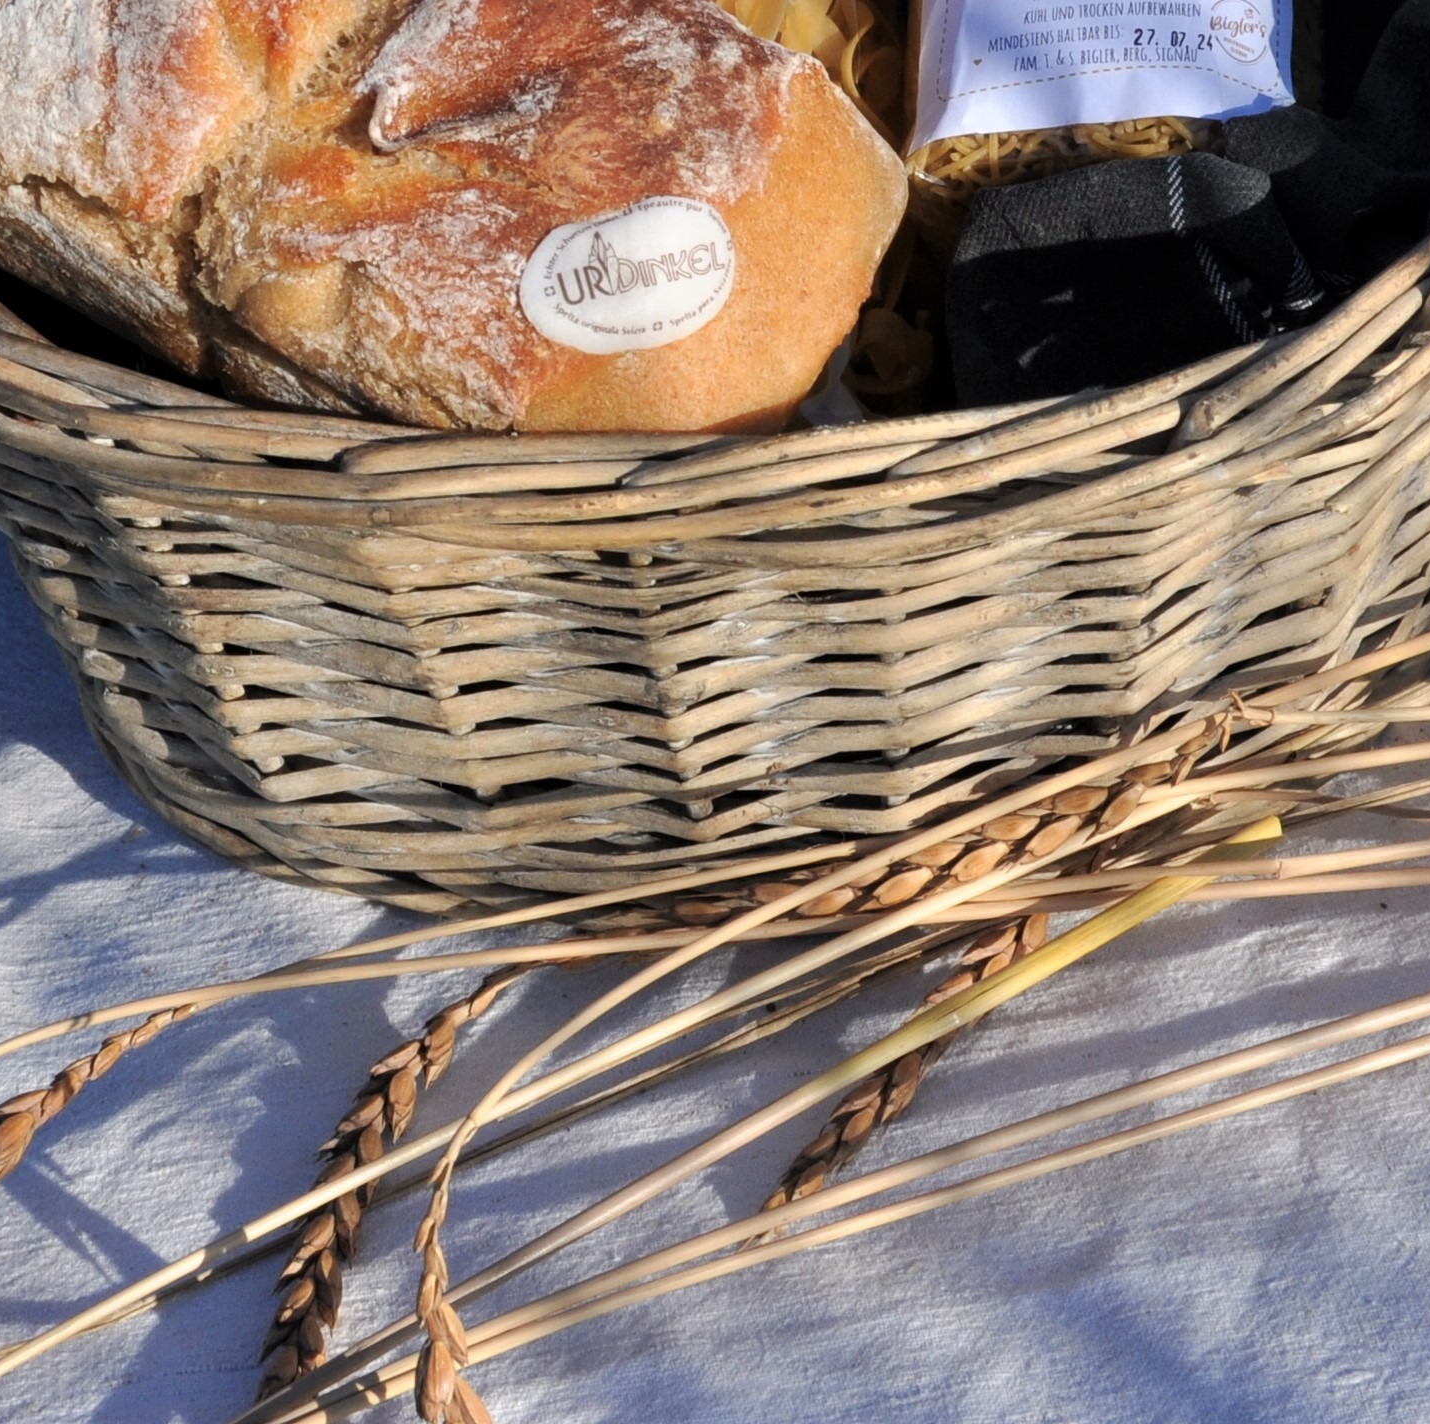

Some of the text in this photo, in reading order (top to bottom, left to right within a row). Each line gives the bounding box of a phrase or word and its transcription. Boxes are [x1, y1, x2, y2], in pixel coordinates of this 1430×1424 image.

[1052, 5, 1075, 21] UND
[1079, 2, 1124, 19] TROCKEN
[1127, 1, 1202, 17] AUFBEWAHREN
[987, 29, 1055, 53] MINDESTENS
[1057, 25, 1101, 44] HALTBAR
[1197, 33, 1214, 51] 24
[1056, 49, 1065, 66] &
[1080, 47, 1120, 65] BIGLER,
[1123, 47, 1152, 63] BERG,
[1155, 46, 1199, 63] SIGNAU
